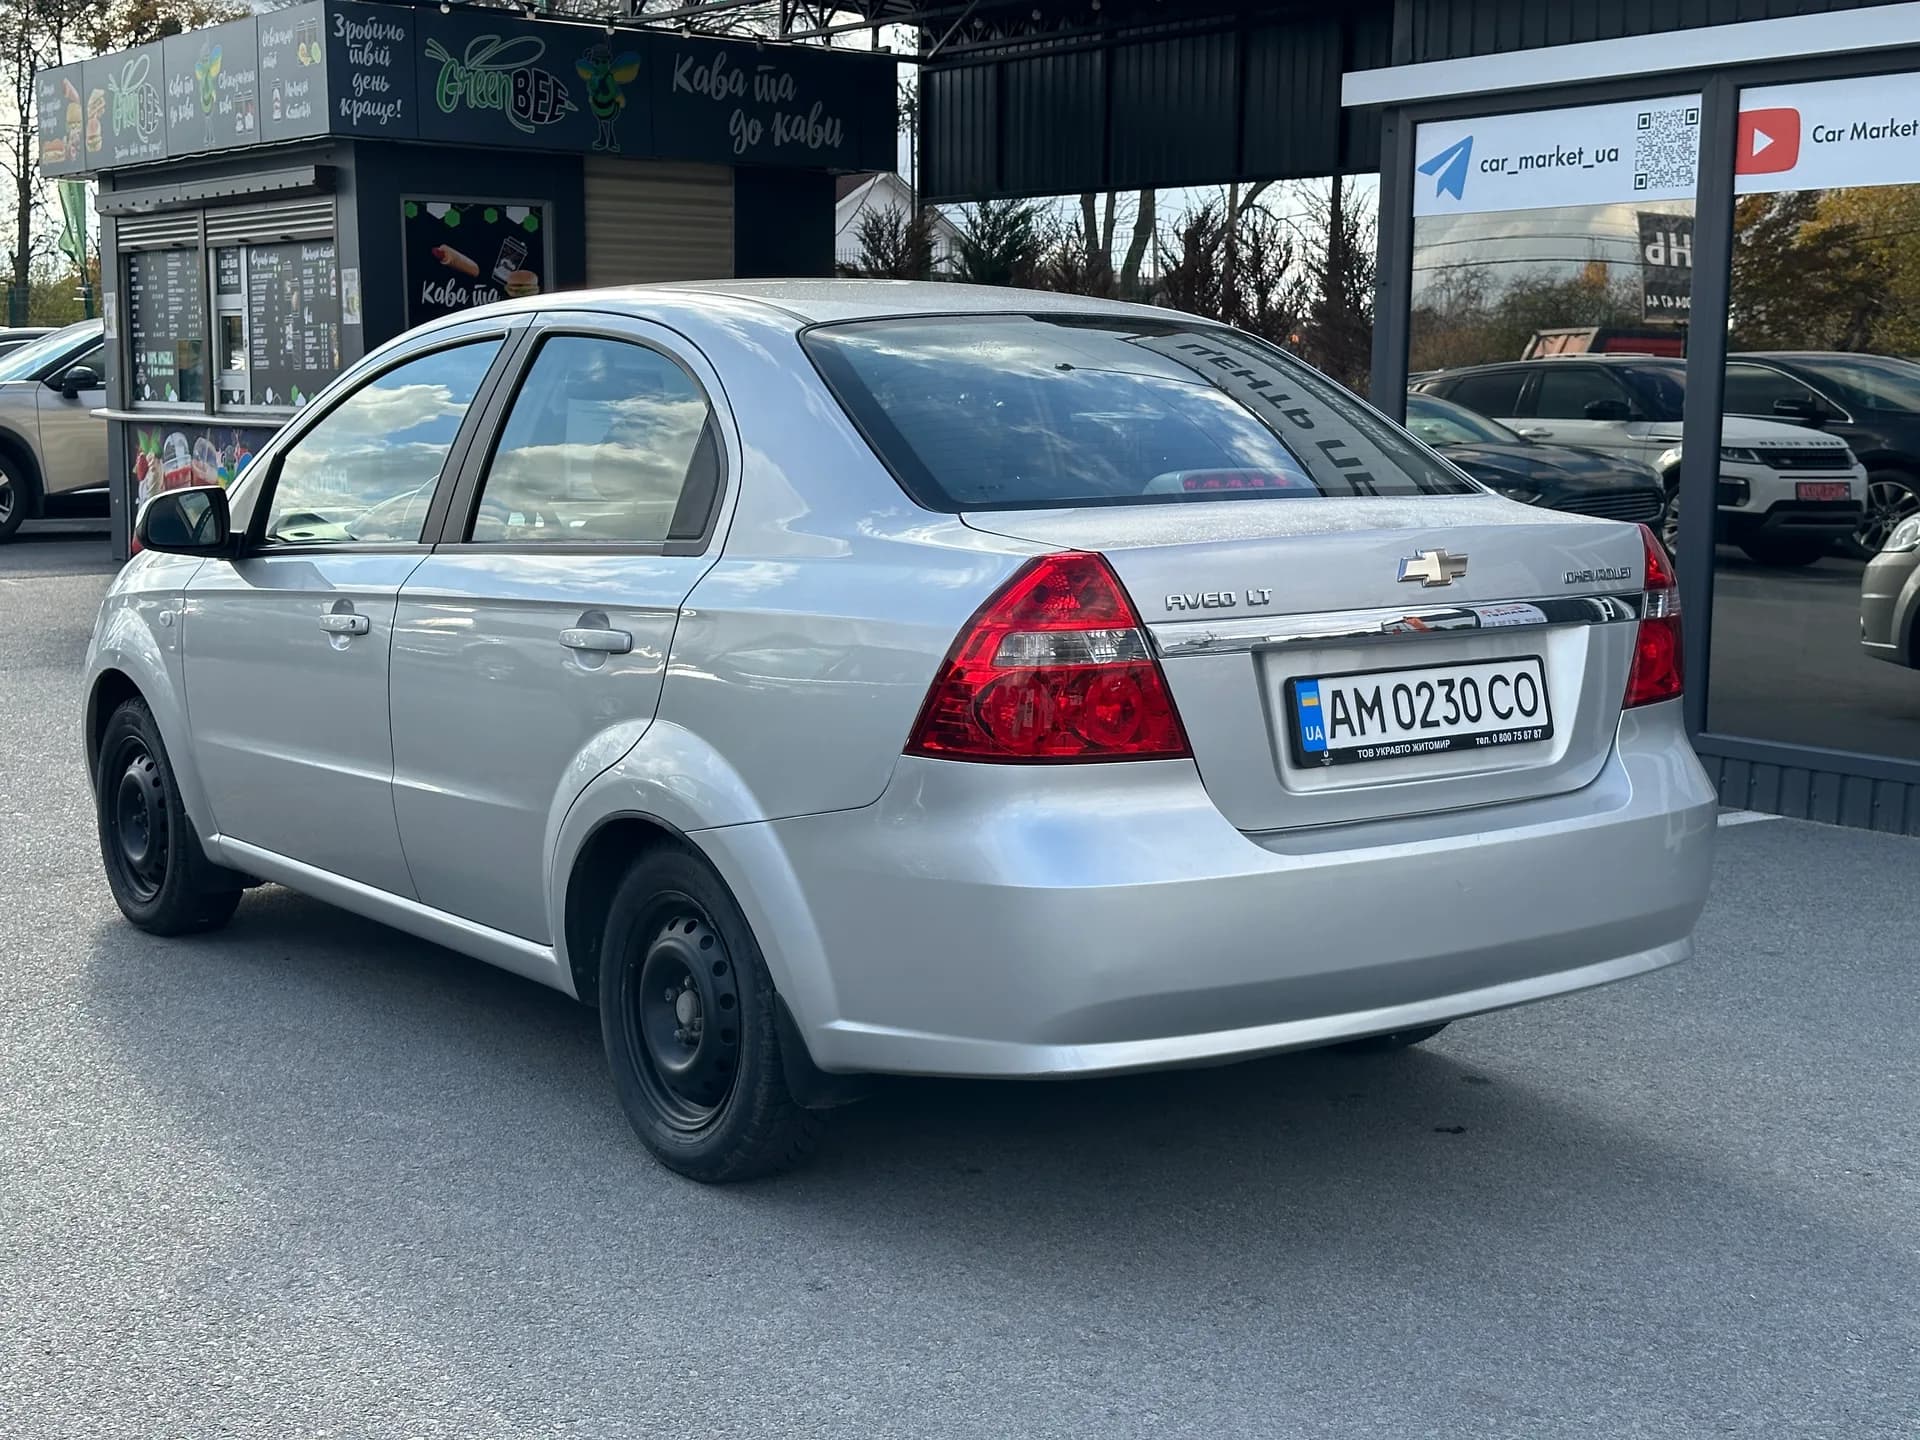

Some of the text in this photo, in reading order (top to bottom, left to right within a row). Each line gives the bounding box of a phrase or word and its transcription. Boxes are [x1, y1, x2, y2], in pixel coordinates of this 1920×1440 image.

[333, 13, 405, 46] Зробимо
[350, 41, 392, 67] твій
[352, 73, 390, 97] день
[672, 51, 797, 103] Кава та
[339, 98, 402, 125] краще!
[729, 101, 844, 154] до кави
[1812, 117, 1919, 143] Car Market
[1480, 145, 1619, 175] car_market_ua
[422, 278, 469, 307] Кава
[1165, 588, 1273, 611] AVEO LT
[1330, 672, 1538, 739] AM 0230 CO
[1305, 726, 1323, 740] UA
[1513, 731, 1523, 741] 75
[1524, 730, 1533, 740] 87
[1533, 729, 1542, 739] 87
[1357, 739, 1450, 758] ТОВ УКРАВТО ЖИТОМИР
